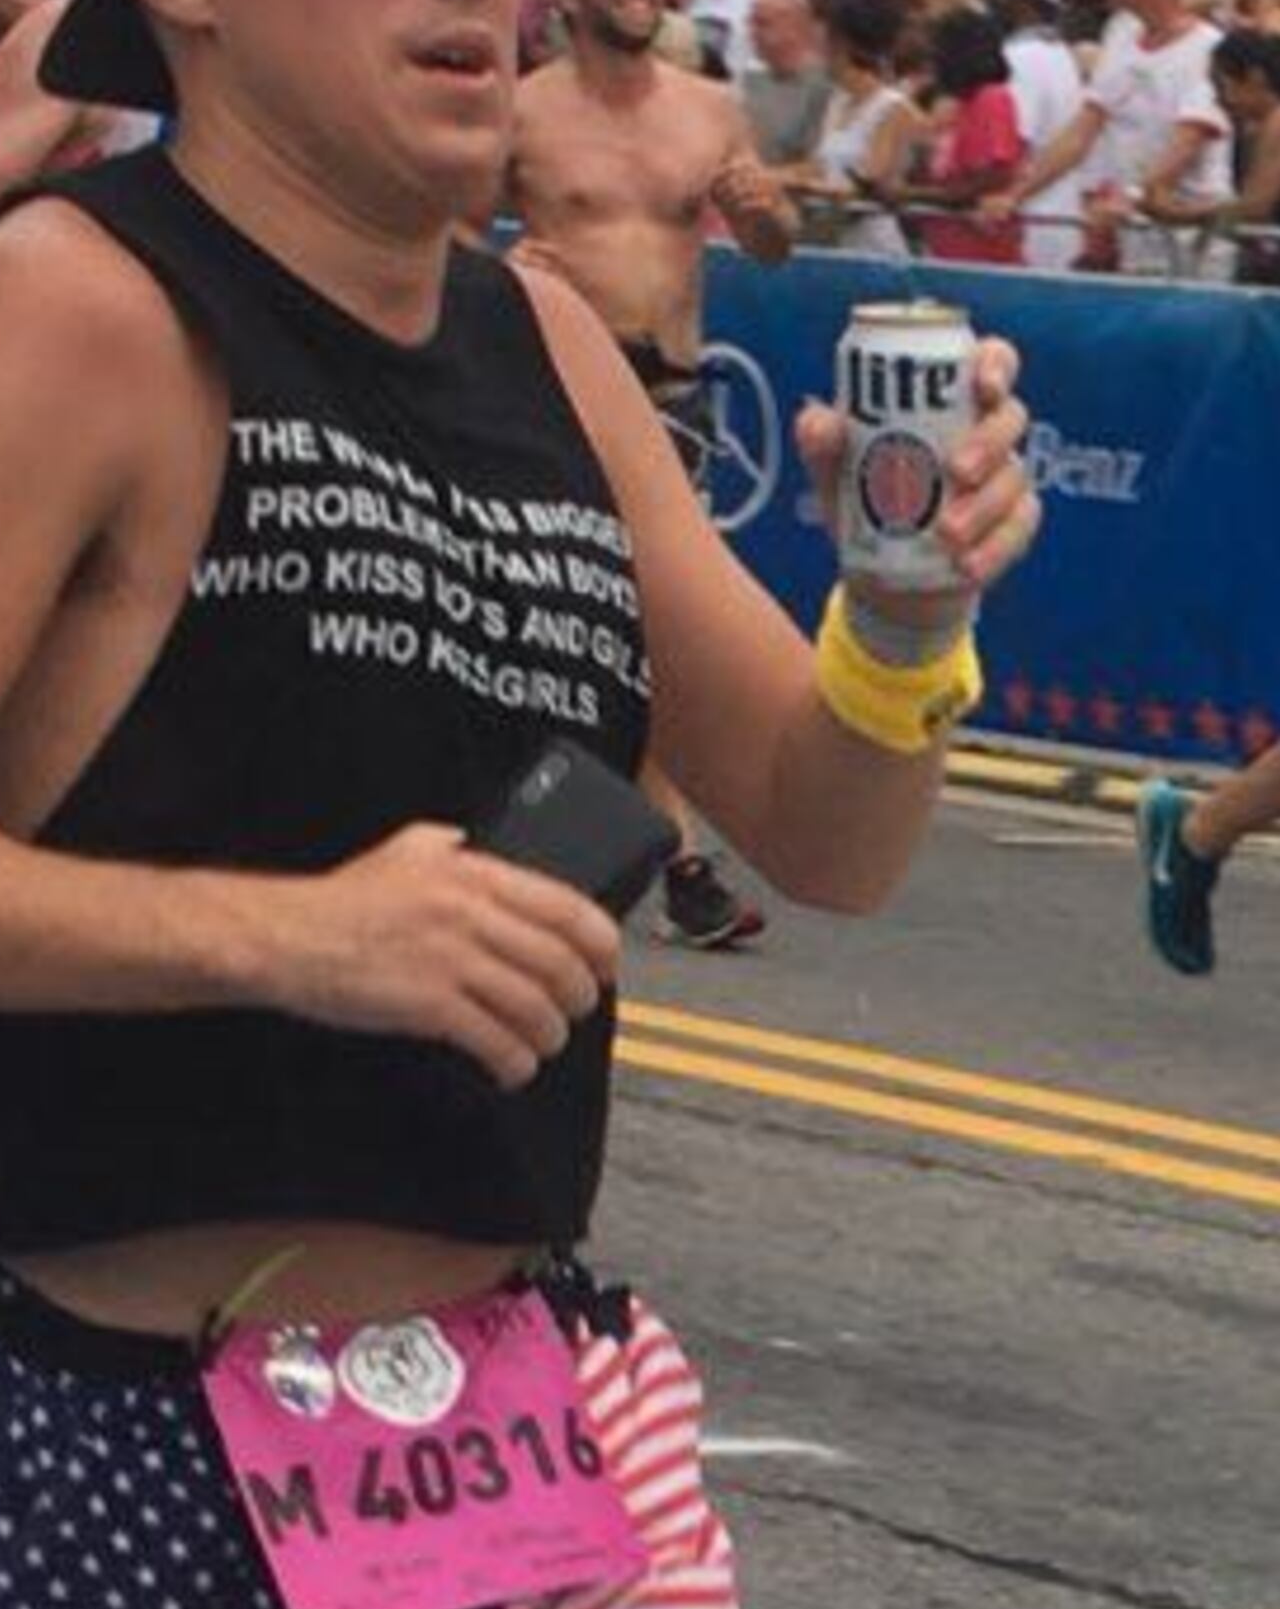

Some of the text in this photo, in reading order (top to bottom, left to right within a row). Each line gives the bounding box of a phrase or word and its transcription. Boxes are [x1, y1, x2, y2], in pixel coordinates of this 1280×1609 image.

[231, 419, 321, 465] THE
[323, 425, 437, 504] WLD
[191, 550, 311, 599] WHO
[325, 550, 424, 602] KISS
[434, 565, 509, 642] OS
[520, 605, 589, 659] AND
[309, 612, 419, 667] WHO
[427, 628, 492, 696] KS
[244, 1406, 604, 1546] M 40316
